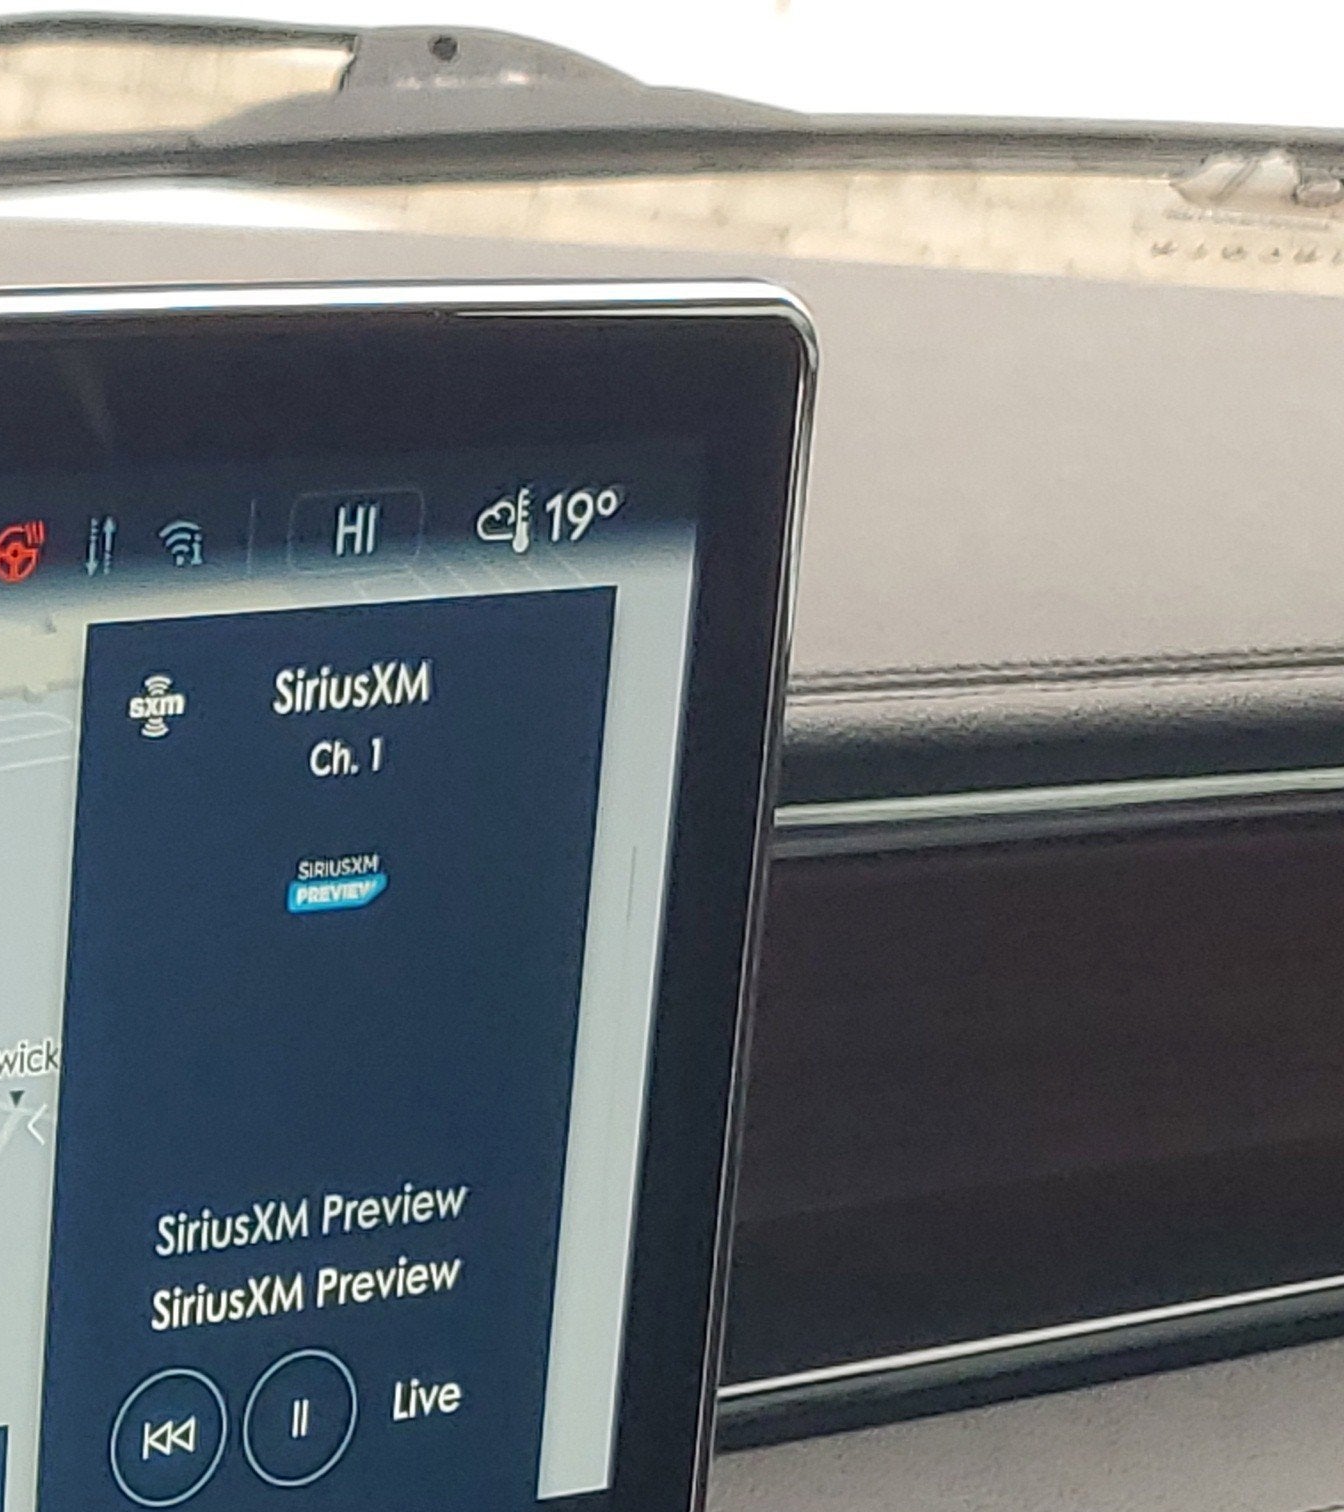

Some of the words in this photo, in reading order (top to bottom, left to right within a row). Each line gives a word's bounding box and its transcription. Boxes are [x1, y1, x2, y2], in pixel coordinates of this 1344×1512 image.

[336, 506, 378, 557] HI
[273, 661, 430, 716] SiriusXM
[310, 742, 359, 778] Ch.
[371, 738, 382, 771] 1
[297, 854, 379, 881] SIRIUSXM
[297, 880, 376, 905] PREVIEW
[156, 1200, 309, 1257] SiriusXM
[322, 1184, 467, 1237] Preview
[151, 1274, 303, 1331] SiriusXM
[317, 1258, 461, 1311] Preview
[393, 1379, 461, 1421] Live
